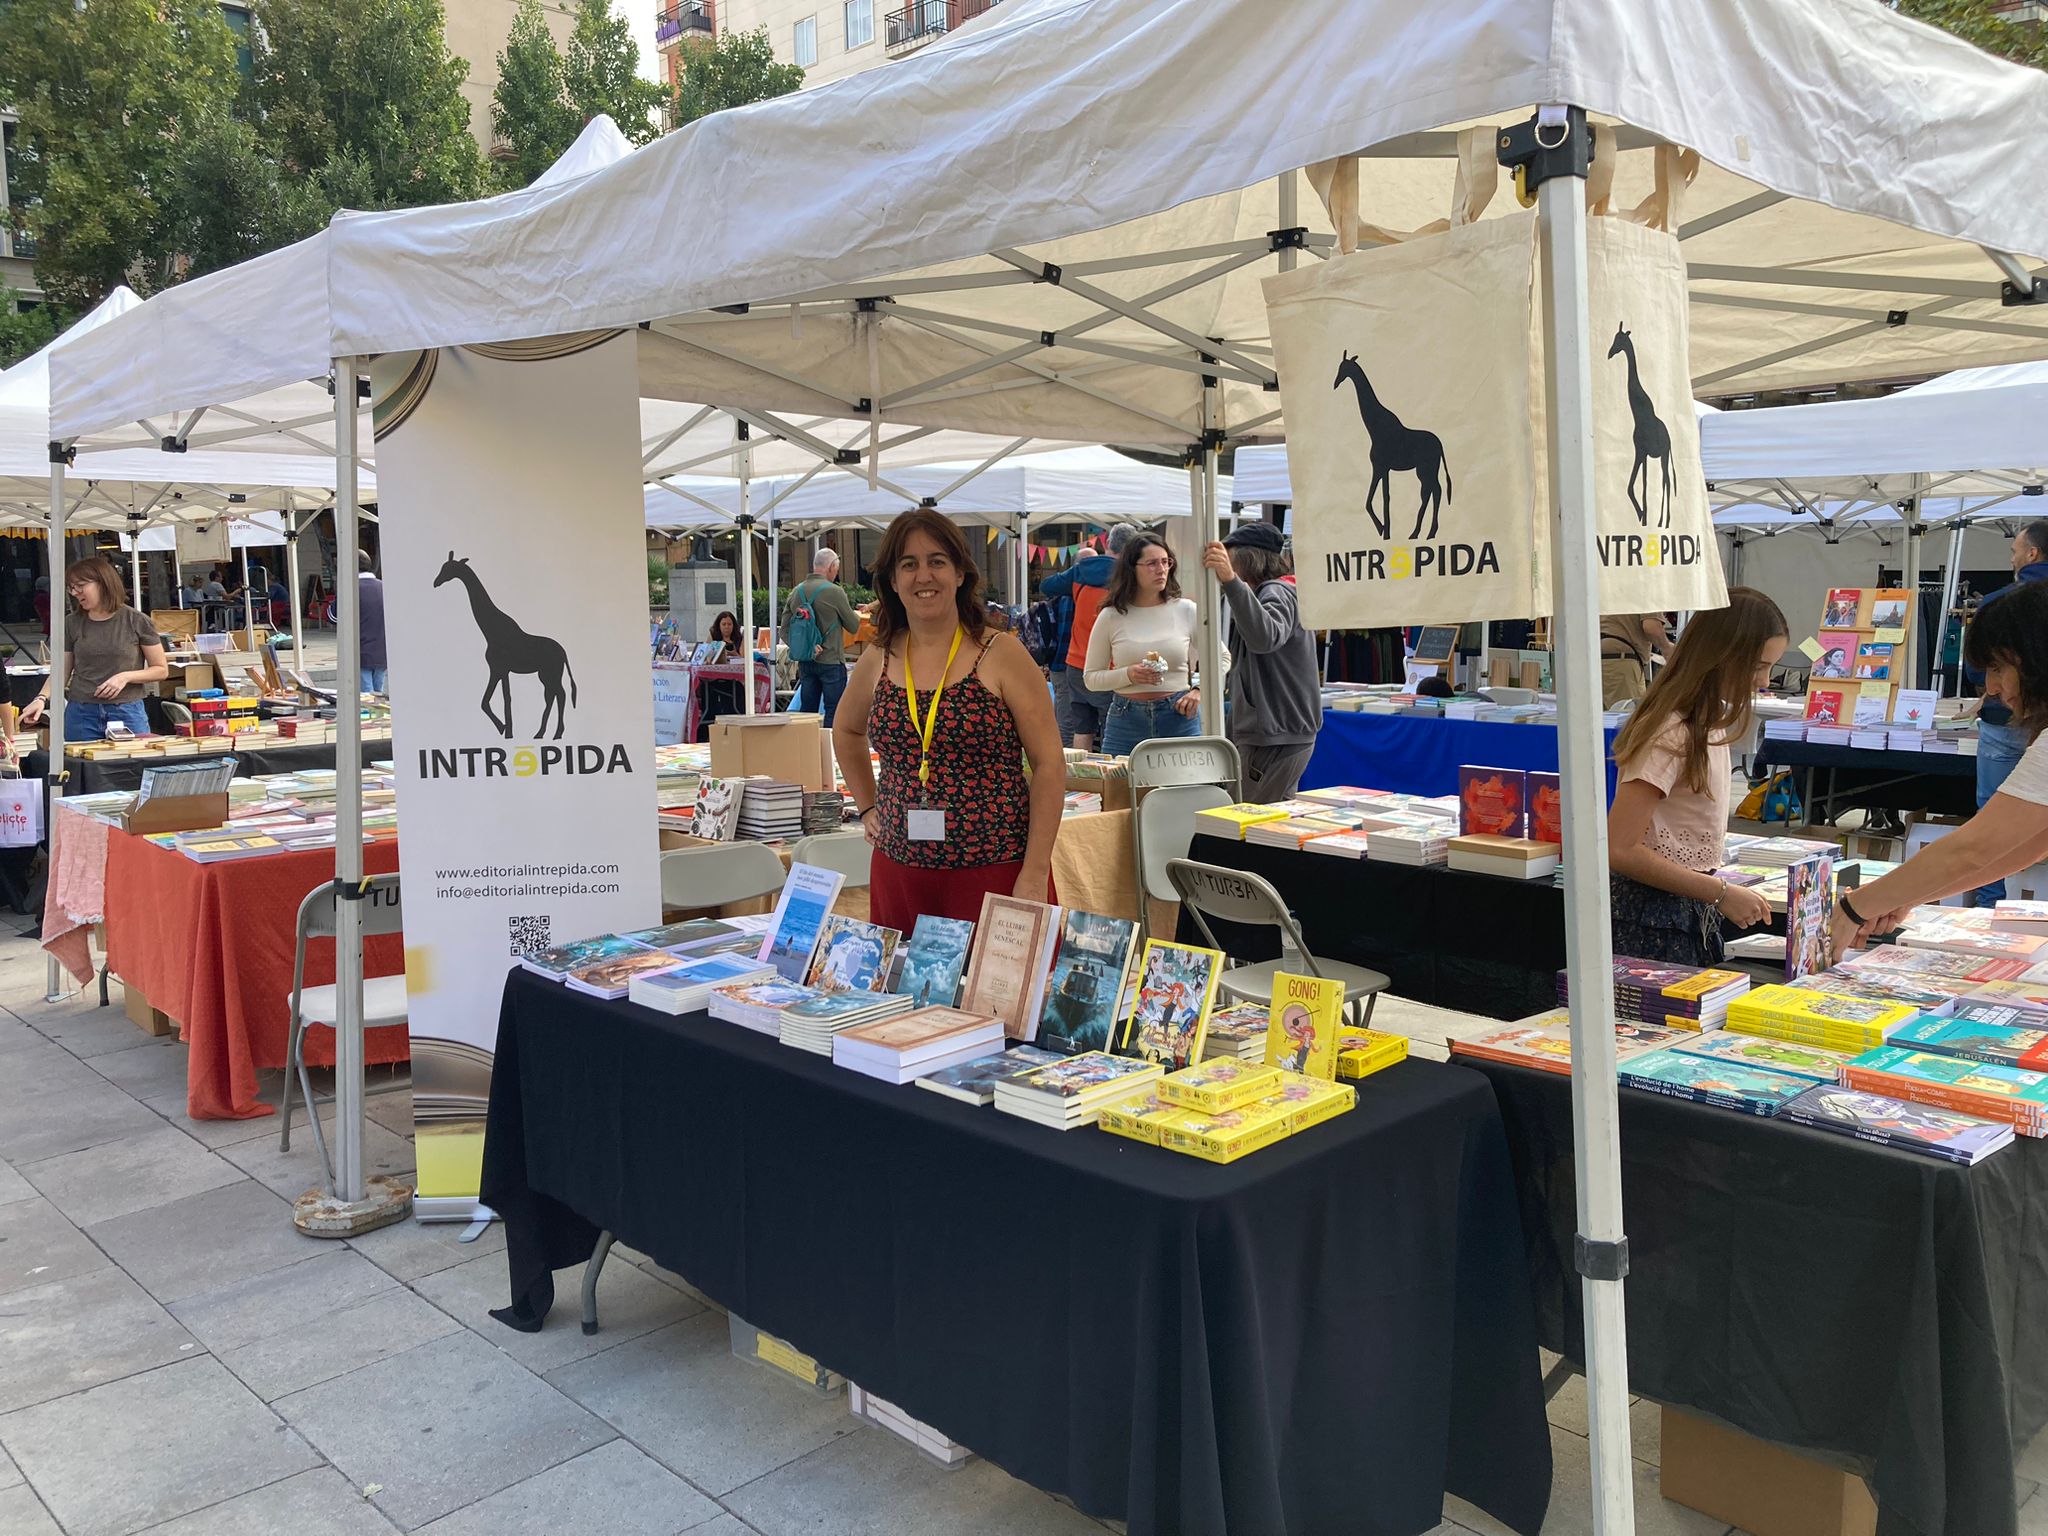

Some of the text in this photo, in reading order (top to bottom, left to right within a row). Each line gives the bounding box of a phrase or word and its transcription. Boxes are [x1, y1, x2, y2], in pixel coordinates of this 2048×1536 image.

[435, 862, 619, 879] www.editorialintrepida.com
[436, 881, 620, 899] info@editorialintrepida.com
[1288, 978, 1321, 1001] GONG!
[1630, 1074, 1662, 1087] L'evolució
[1672, 1083, 1695, 1094] l'home
[1630, 1081, 1660, 1093] L'evolució
[1662, 1088, 1670, 1096] de
[1671, 1089, 1694, 1100] l'home
